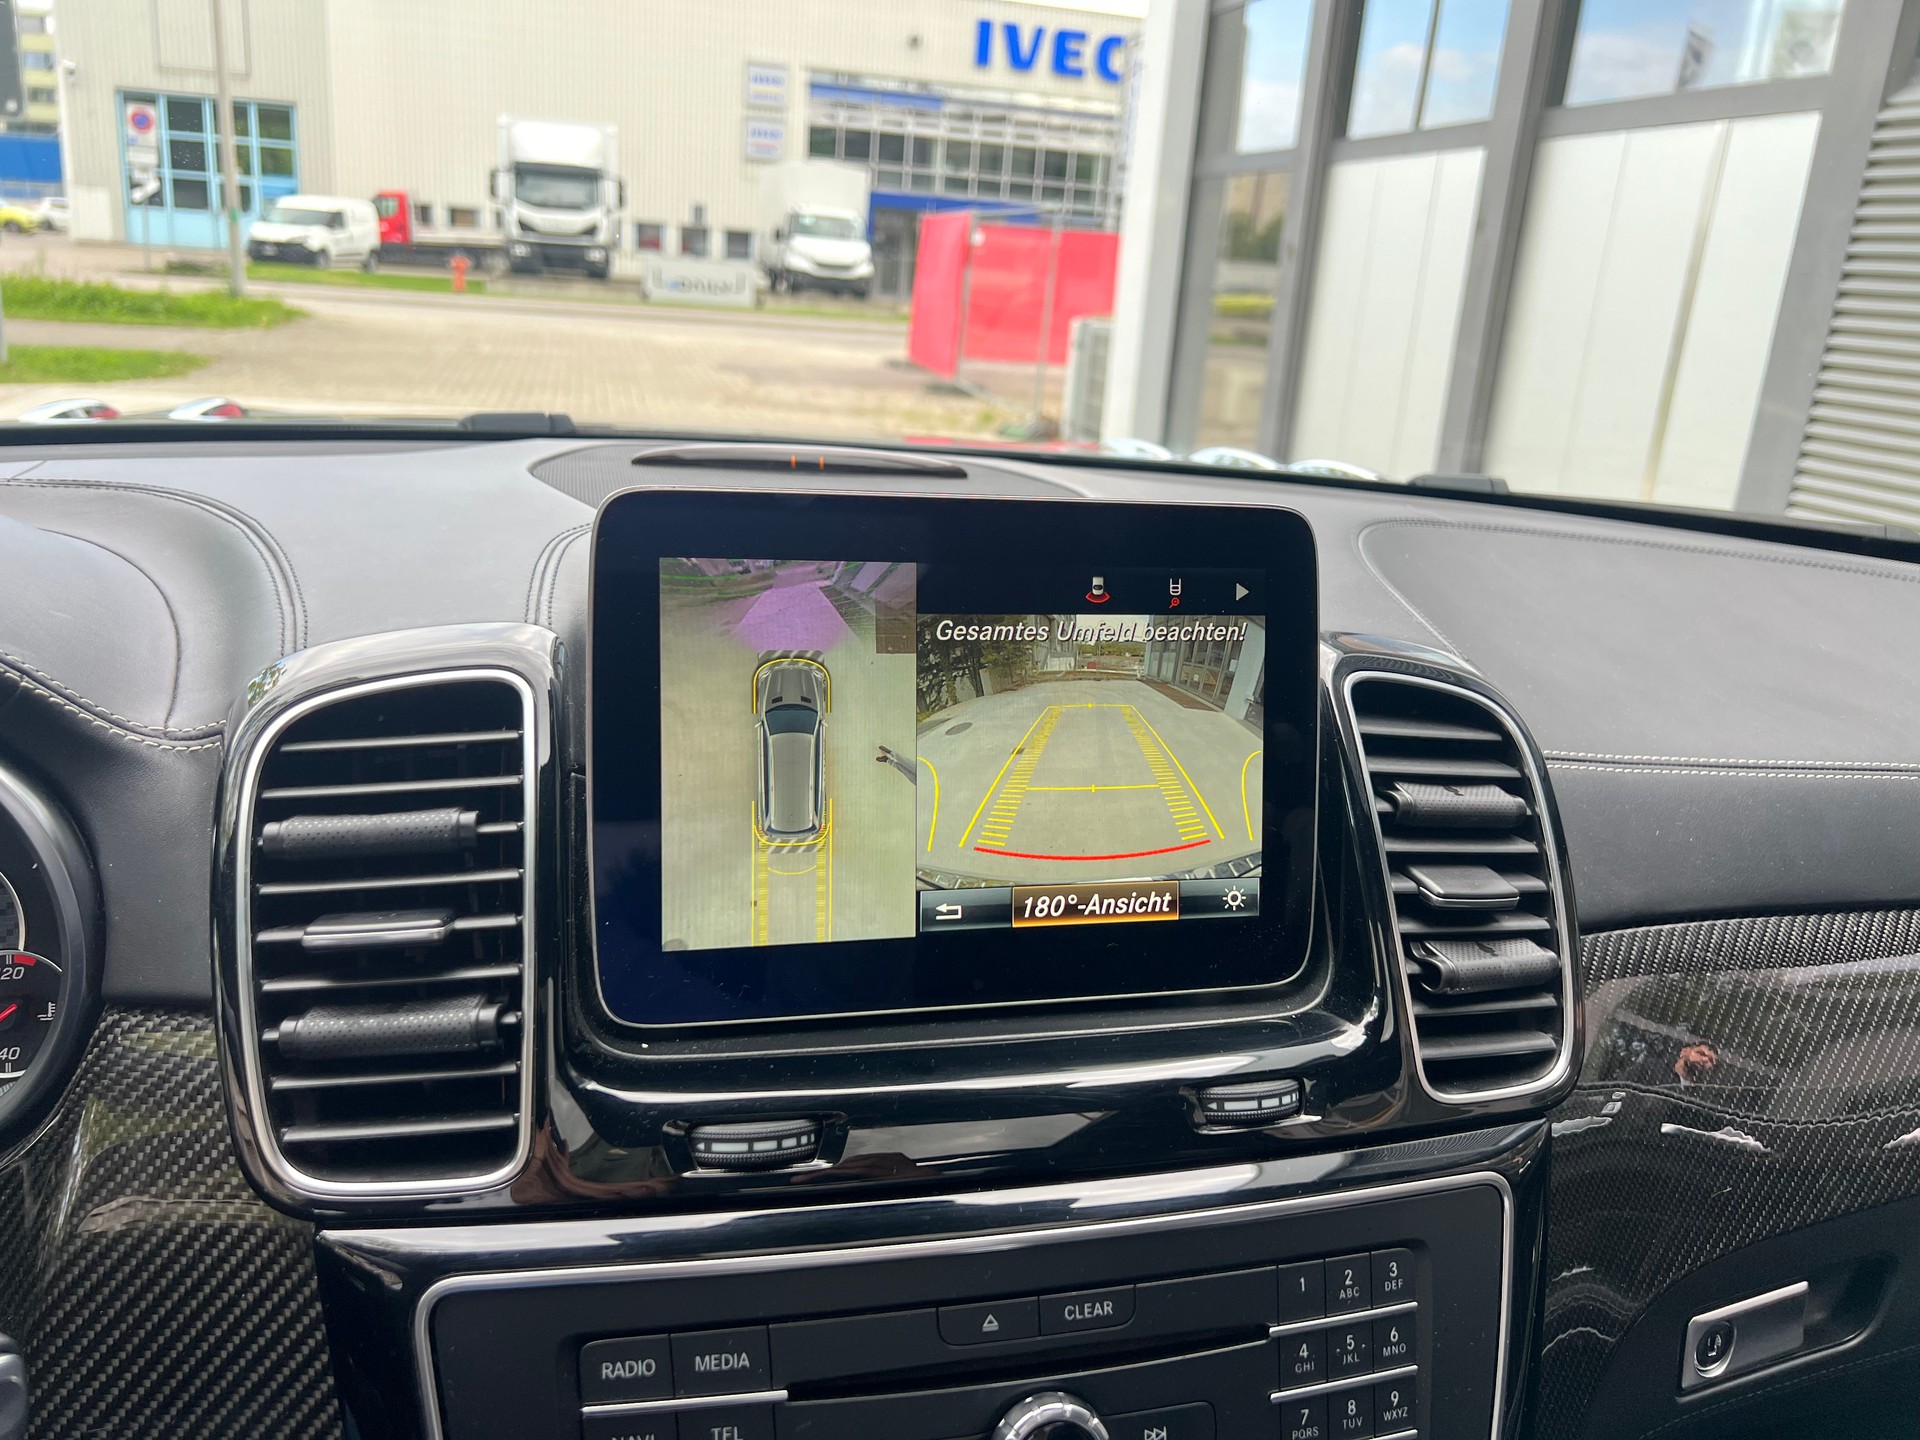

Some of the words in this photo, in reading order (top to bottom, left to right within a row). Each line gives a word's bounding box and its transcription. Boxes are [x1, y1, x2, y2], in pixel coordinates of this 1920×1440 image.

[935, 619, 1049, 642] Gesamtes
[1056, 620, 1138, 642] Umfeld
[1142, 621, 1249, 643] beachten!
[1023, 891, 1172, 919] 180°-Ansicht
[0, 966, 25, 980] 20
[0, 1047, 21, 1060] 40
[1344, 1269, 1353, 1285] 2
[1389, 1261, 1398, 1277] 3
[1300, 1277, 1305, 1291] 1
[1384, 1279, 1403, 1291] DEF
[1339, 1287, 1360, 1299] ABC
[1064, 1300, 1113, 1321] CLEAR
[1346, 1334, 1355, 1350] 5
[1390, 1326, 1399, 1342] 6
[1299, 1343, 1309, 1359] 4
[1383, 1343, 1406, 1357] MNO
[694, 1352, 750, 1372] MEDIA
[1295, 1361, 1315, 1373] GHI
[1342, 1352, 1361, 1366] JKL
[601, 1358, 656, 1380] RADIO
[1390, 1390, 1399, 1407] 9
[1347, 1399, 1356, 1415] 8
[1383, 1407, 1408, 1421] WXYZ
[1300, 1408, 1310, 1426] 7
[1342, 1417, 1363, 1429] TUV
[1292, 1426, 1319, 1440] PQRS
